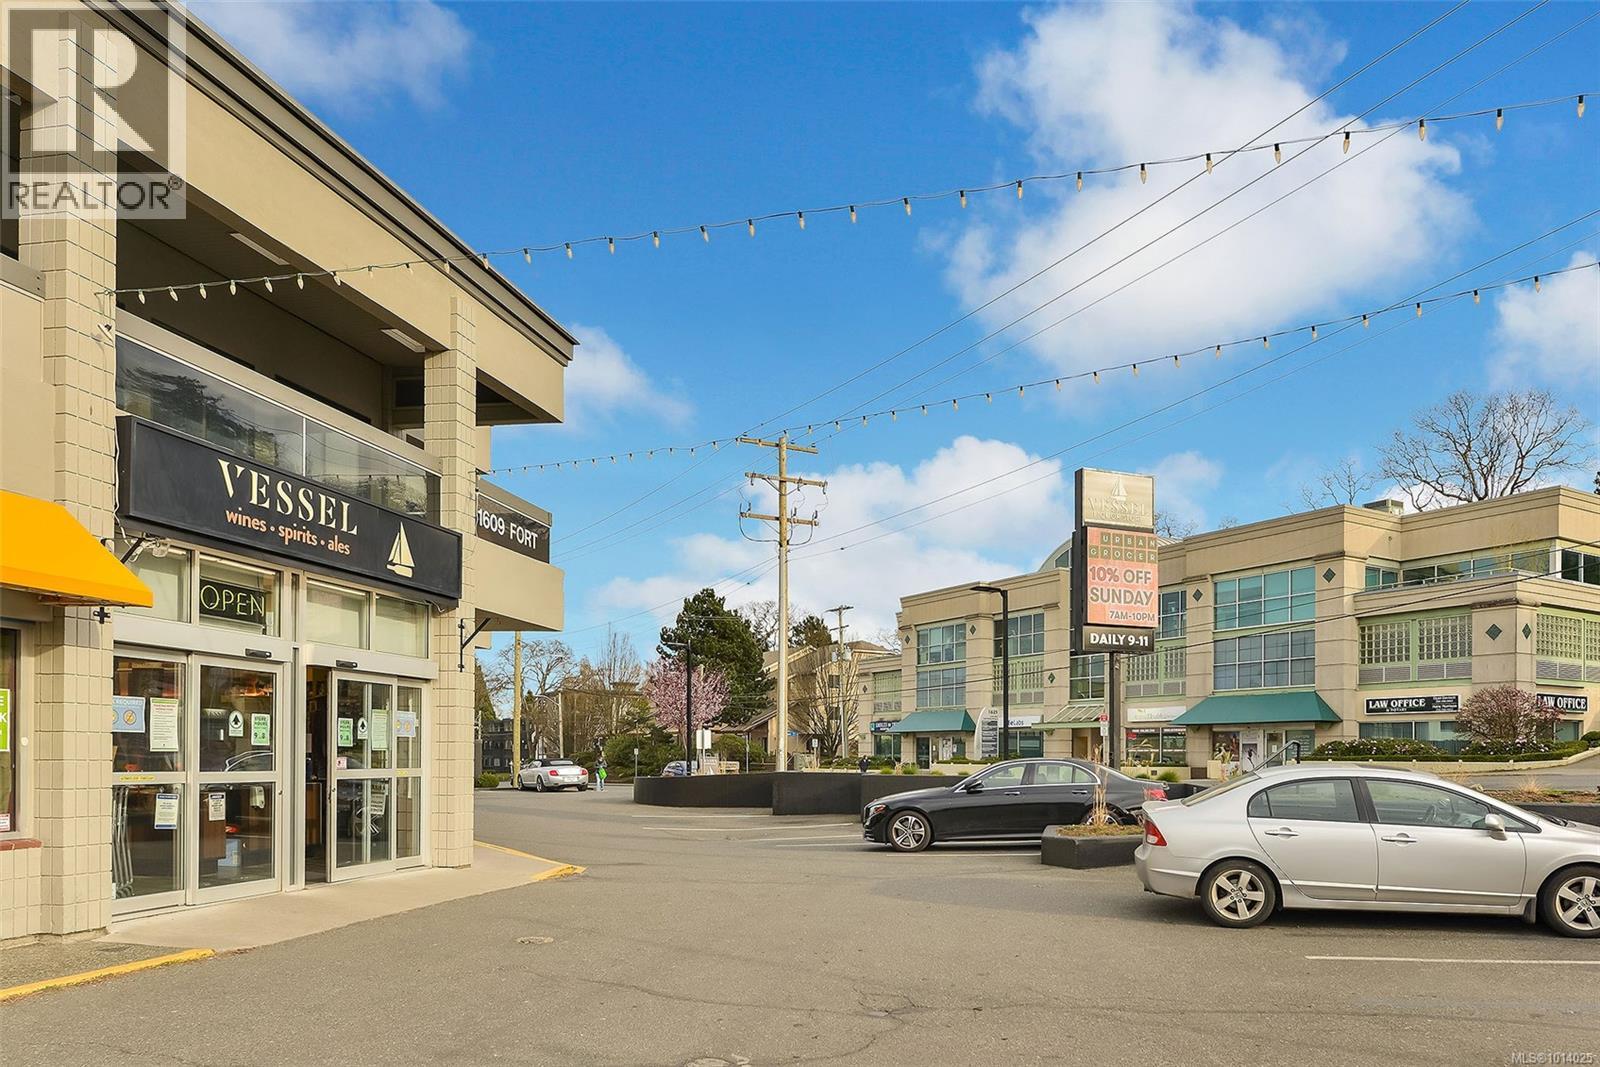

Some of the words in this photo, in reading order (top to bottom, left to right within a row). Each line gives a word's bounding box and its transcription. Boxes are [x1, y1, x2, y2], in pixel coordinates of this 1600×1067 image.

[218, 459, 358, 536] VESSEL
[1088, 497, 1148, 516] VESSEL
[225, 507, 267, 532] wines
[278, 523, 318, 546] spirits
[328, 535, 351, 555] ales
[478, 508, 505, 536] 1609
[510, 523, 539, 549] FORT
[1102, 535, 1155, 547] URBAN
[1091, 548, 1155, 561] GROCER
[1089, 566, 1120, 582] 10%
[1123, 569, 1152, 584] OFF
[200, 584, 265, 617] OPEN
[1090, 587, 1153, 606] SUNDAY
[1109, 610, 1155, 622] 7AM-10PM
[1090, 632, 1126, 645] DAILY
[1127, 635, 1149, 647] 9-11
[1369, 700, 1389, 709] LAW
[1390, 698, 1426, 708] OFFICE
[1556, 696, 1587, 710] OFFICE
